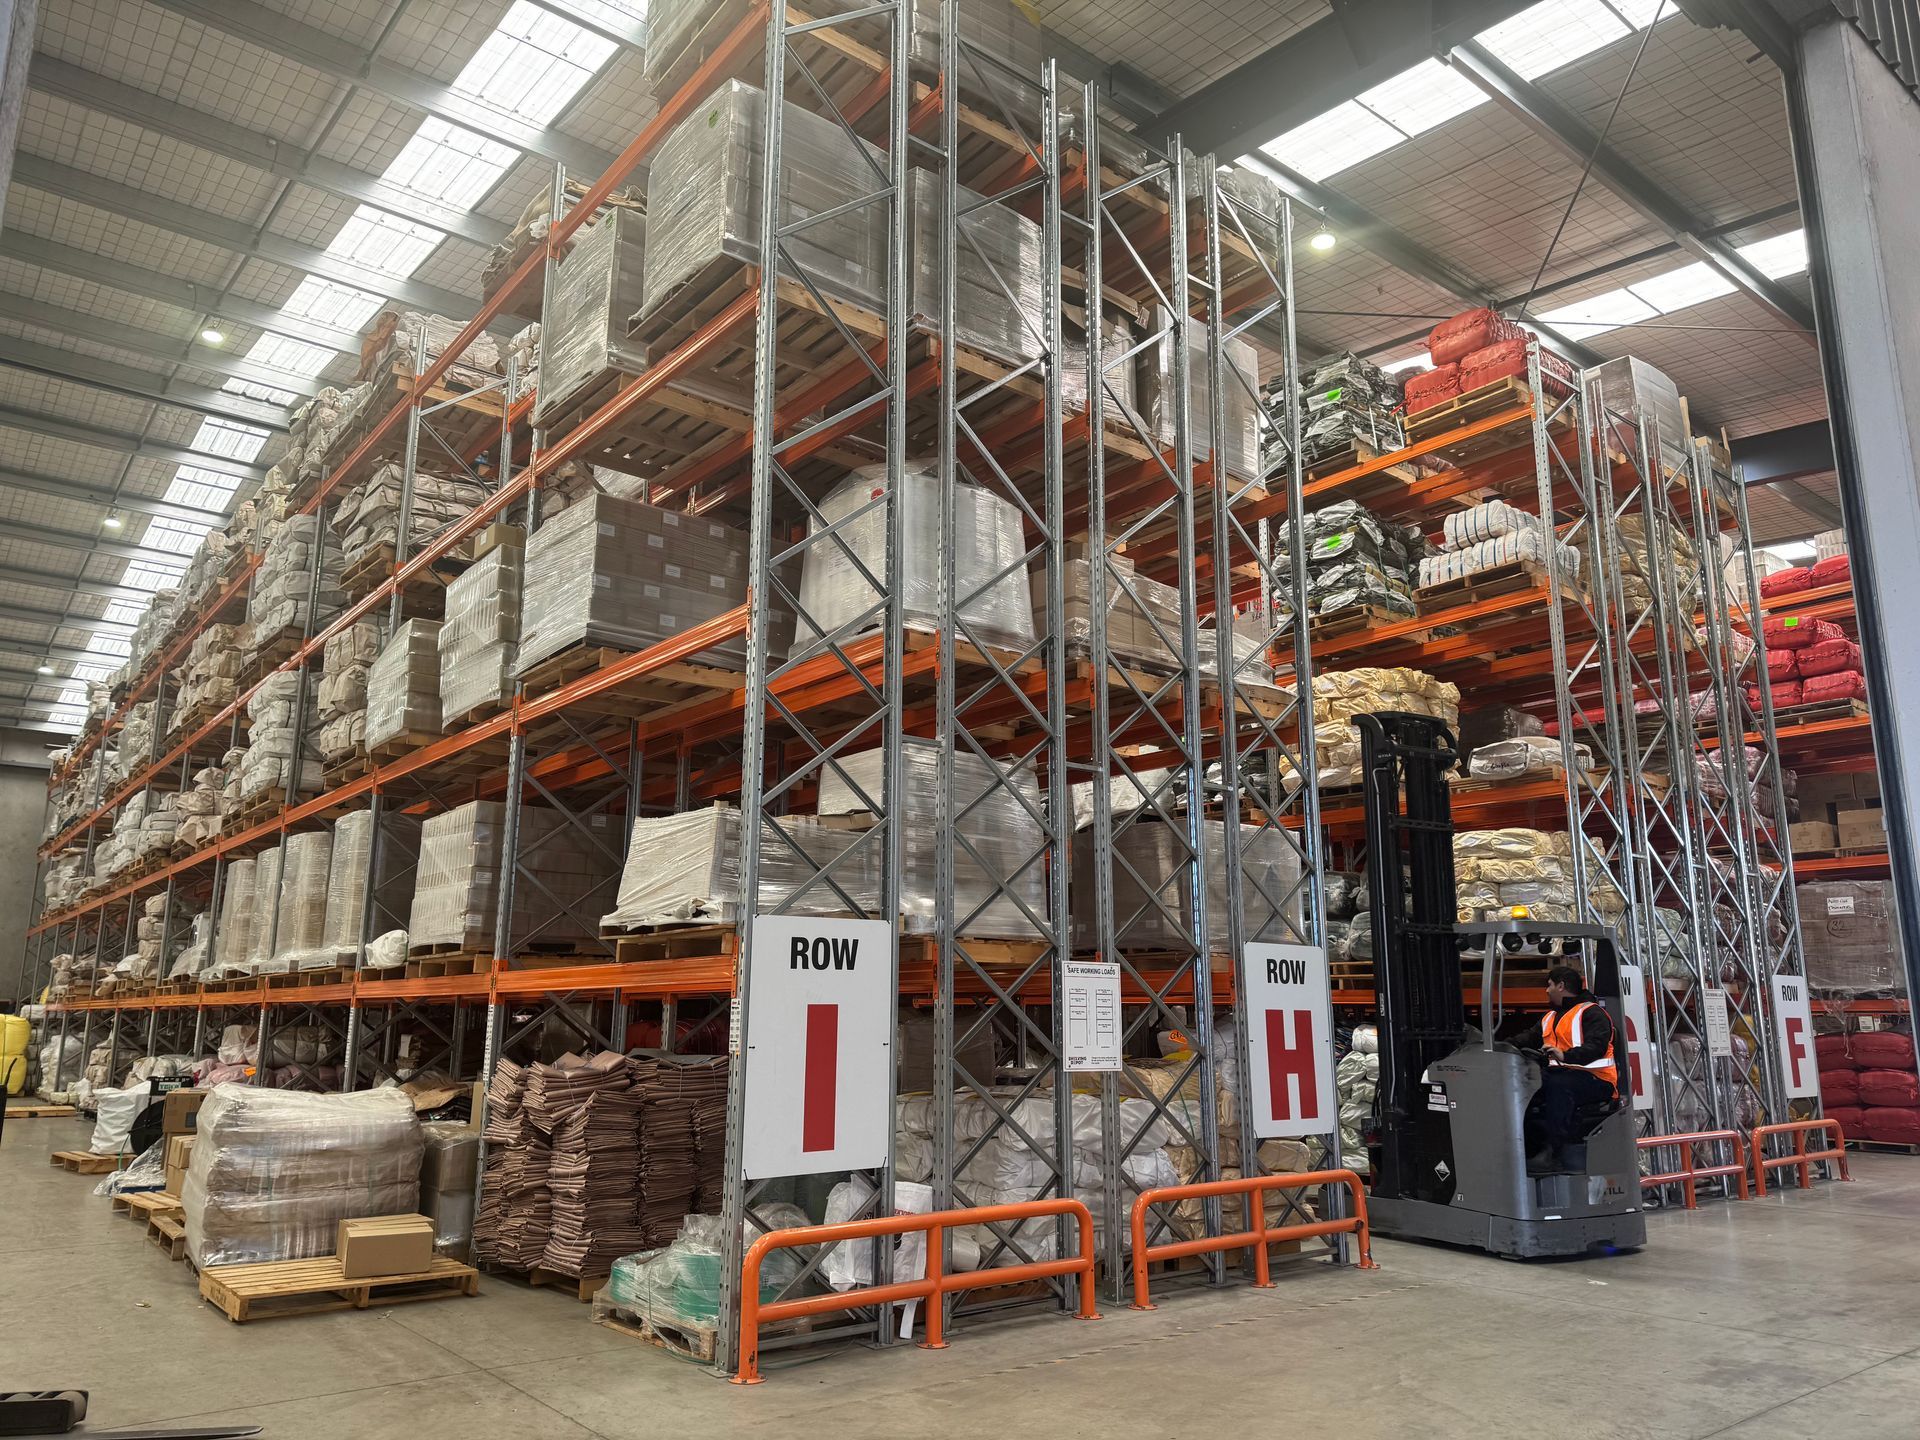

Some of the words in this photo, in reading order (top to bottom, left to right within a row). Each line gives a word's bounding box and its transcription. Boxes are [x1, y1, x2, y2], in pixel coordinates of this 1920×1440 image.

[790, 936, 859, 971] ROW
[1266, 958, 1306, 985] ROW
[1781, 985, 1799, 1002] ROW
[802, 1004, 839, 1152] I
[1265, 1009, 1318, 1120] H
[1785, 1017, 1806, 1088] F
